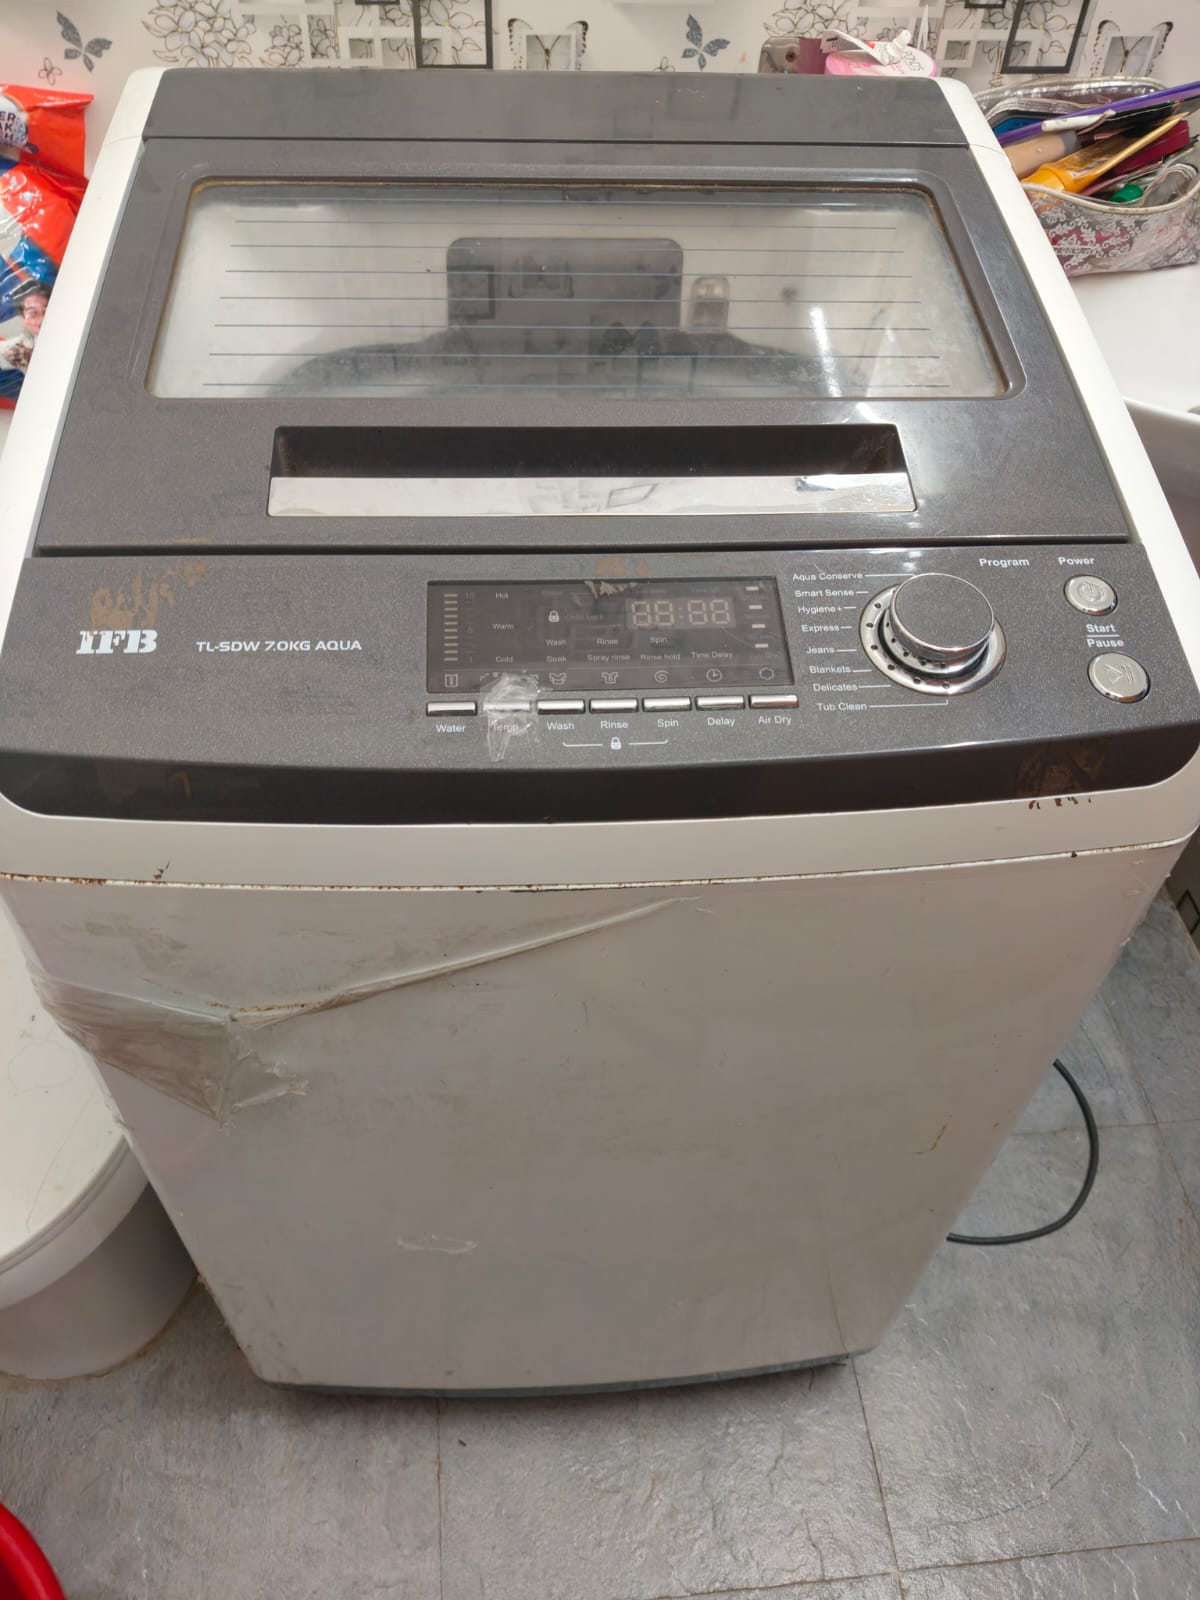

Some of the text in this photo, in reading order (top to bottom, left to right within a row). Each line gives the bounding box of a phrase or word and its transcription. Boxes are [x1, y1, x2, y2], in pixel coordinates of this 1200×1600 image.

[979, 558, 1030, 568] Program
[1058, 556, 1095, 565] Power
[793, 572, 863, 581] Aqua Conserve
[795, 588, 854, 597] Smart Sense
[801, 624, 840, 633] Express
[1086, 623, 1117, 633] Start
[76, 629, 158, 655] IFB
[596, 637, 619, 645] Rinse
[1086, 638, 1125, 648] Pause
[196, 640, 363, 652] TL-SDW 7.0KG AQUA
[806, 646, 835, 654] Jeans
[495, 655, 514, 663] Cold
[587, 654, 610, 663] Spray
[809, 665, 852, 674] Blankets
[812, 683, 858, 692] Delicates
[816, 702, 868, 711] Tub Clean
[600, 720, 628, 729] Rinse
[657, 718, 679, 728] Spin
[707, 717, 735, 727] Delay
[758, 715, 792, 725] Air Dry
[436, 723, 466, 733] Water
[546, 721, 575, 730] Wash
